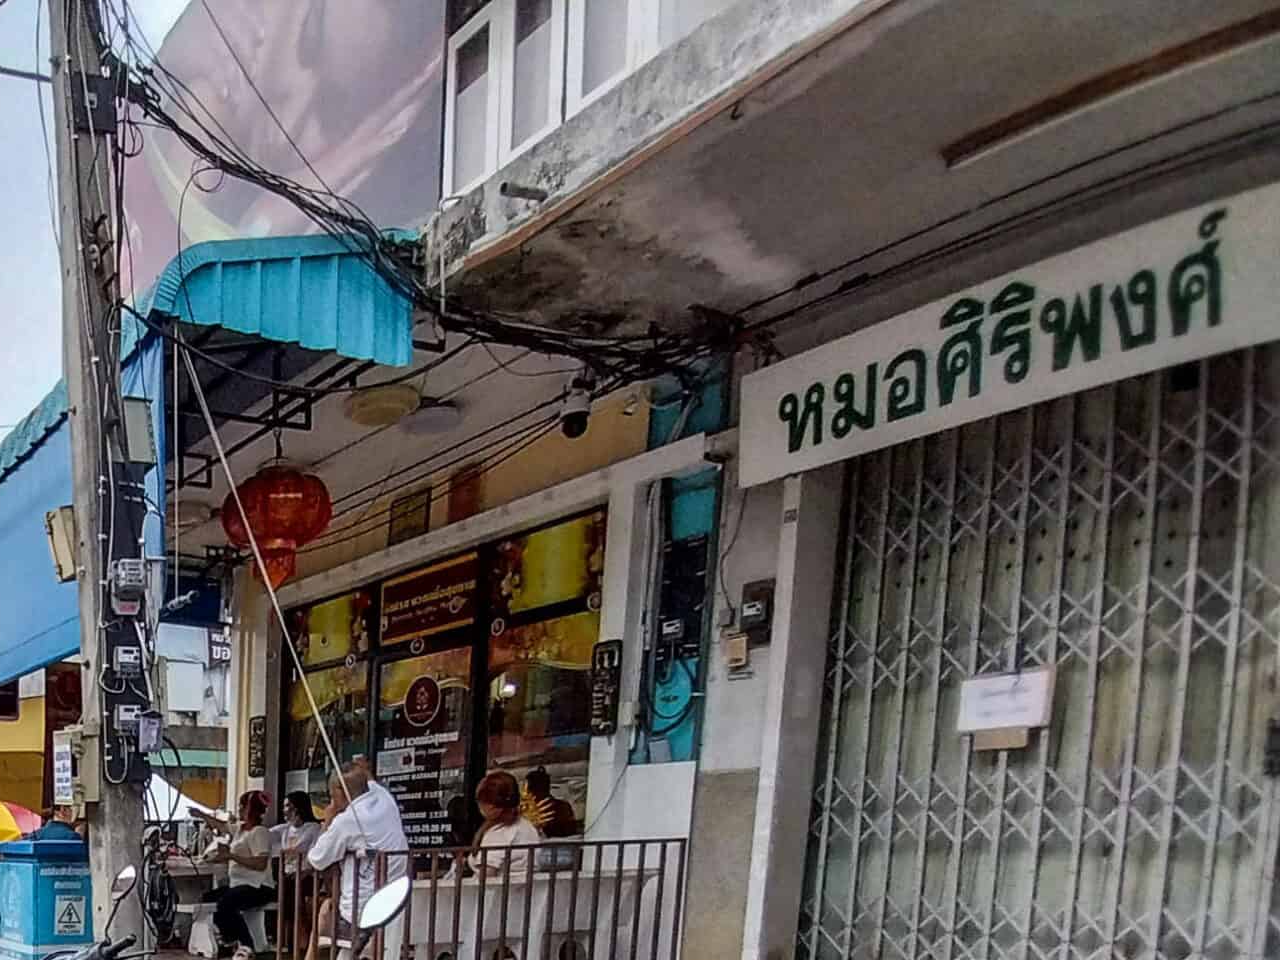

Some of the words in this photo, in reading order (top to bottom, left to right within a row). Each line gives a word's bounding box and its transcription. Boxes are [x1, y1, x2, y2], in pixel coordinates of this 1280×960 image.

[778, 207, 1228, 453] หมอศิริพงศ์
